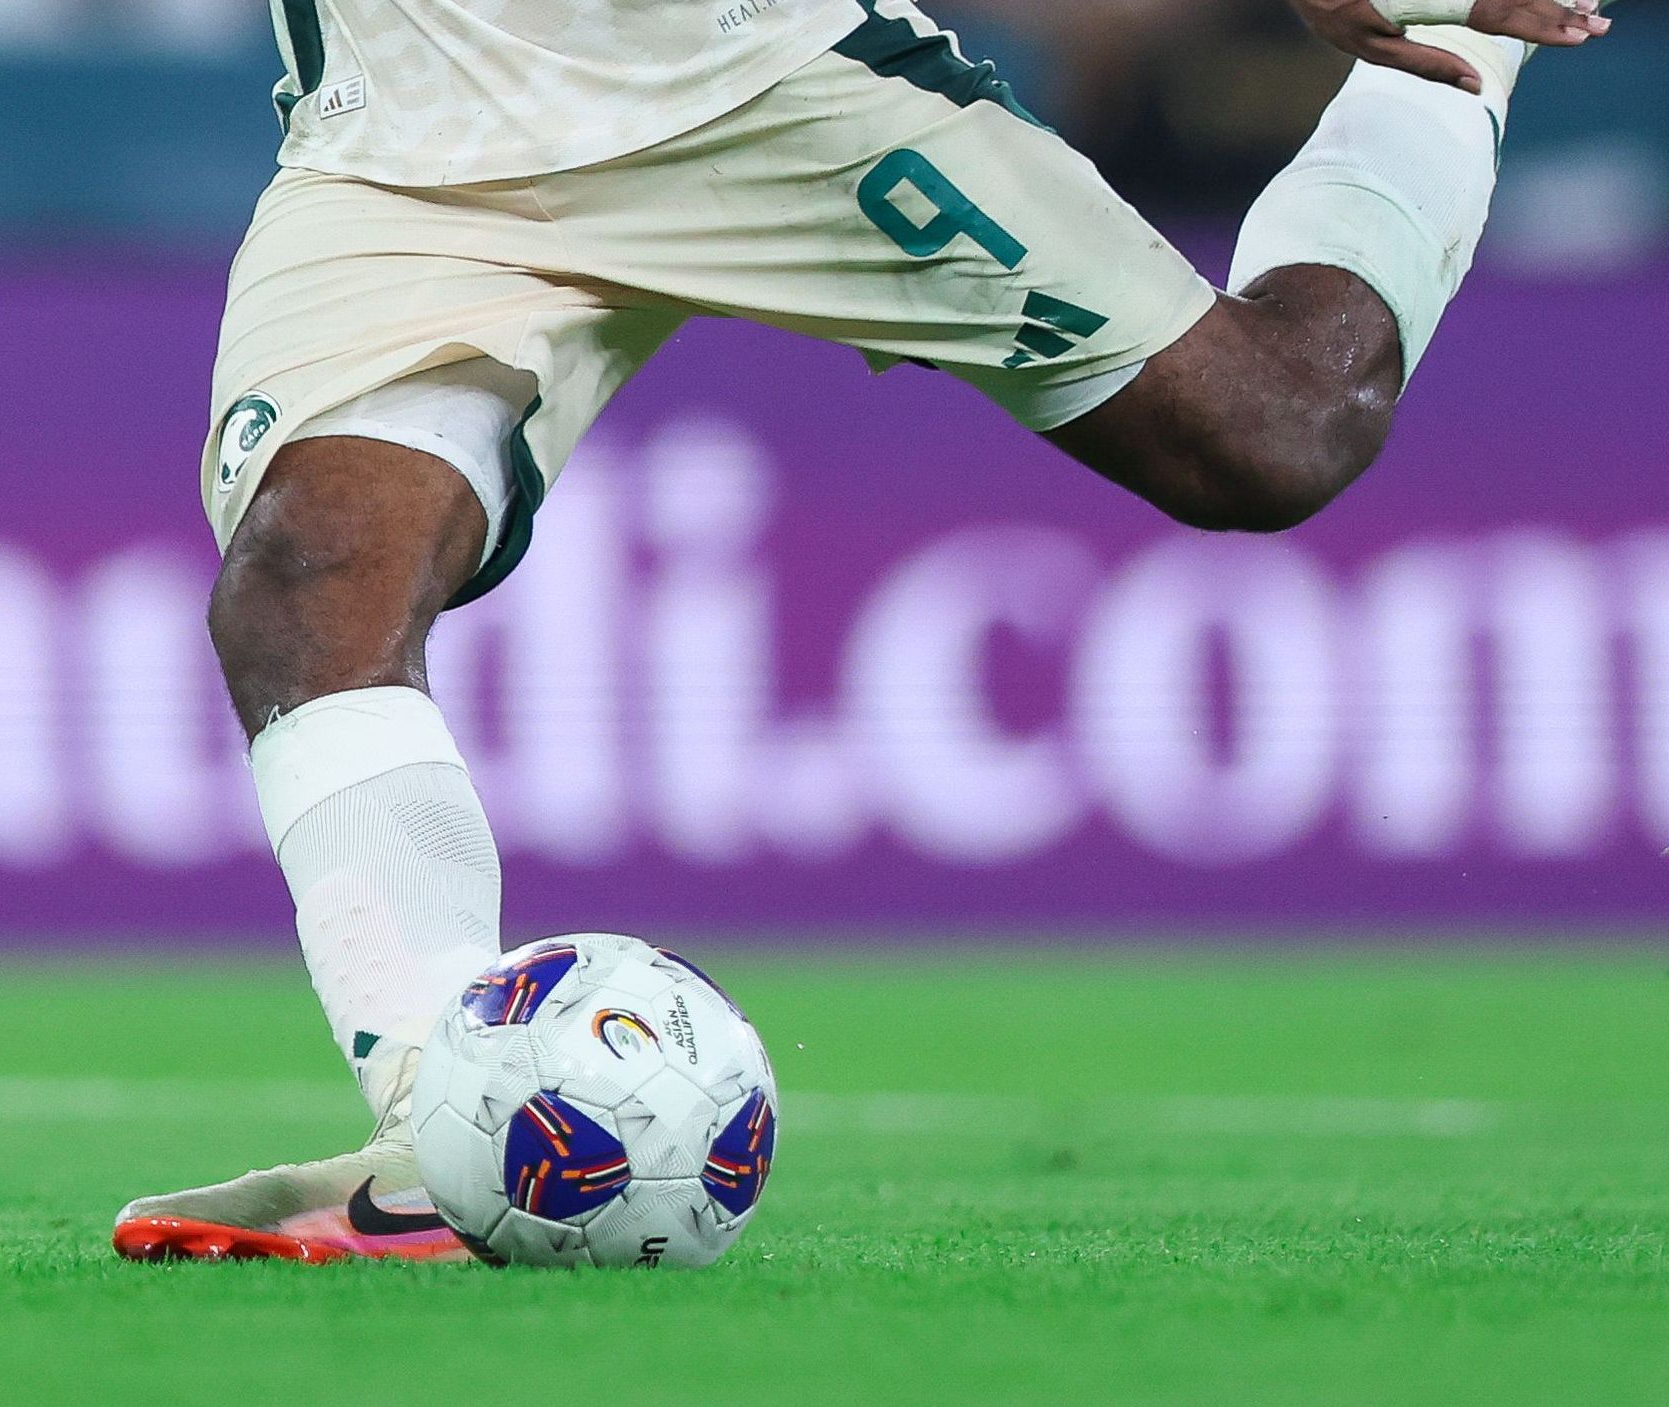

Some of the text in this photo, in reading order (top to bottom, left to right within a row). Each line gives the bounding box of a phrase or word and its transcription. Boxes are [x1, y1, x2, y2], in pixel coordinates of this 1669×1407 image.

[857, 148, 1029, 271] 9
[667, 1009, 686, 1049] ASIAN
[675, 994, 698, 1066] QUALIFIERS
